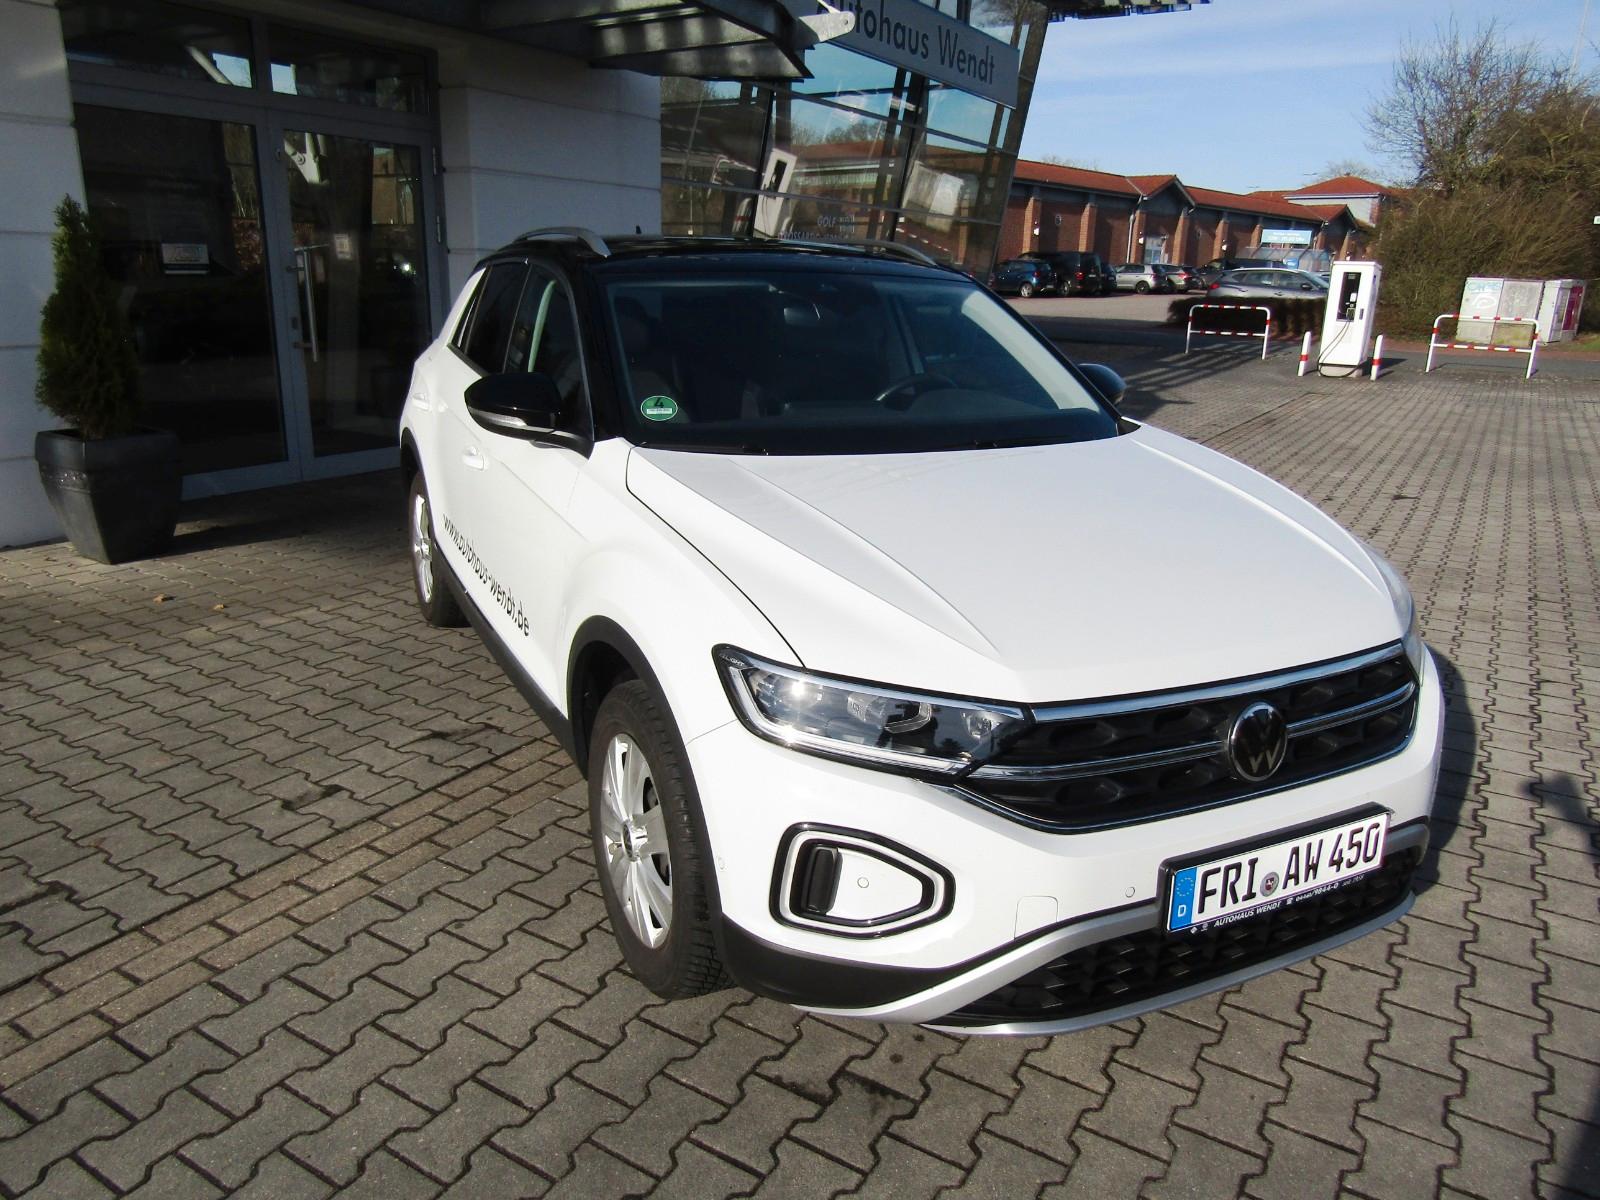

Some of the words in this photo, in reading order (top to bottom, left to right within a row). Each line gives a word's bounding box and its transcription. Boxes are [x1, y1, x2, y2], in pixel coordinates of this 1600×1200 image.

[938, 25, 995, 84] Wendt
[654, 397, 665, 408] 4
[443, 513, 529, 637] www.autohaus-wendt.de
[1197, 857, 1259, 914] FRI
[1282, 838, 1323, 890] AW
[1328, 822, 1380, 873] 450
[1178, 904, 1186, 918] D
[1213, 908, 1254, 928] AUTOHAUS
[1256, 901, 1281, 915] WENDT
